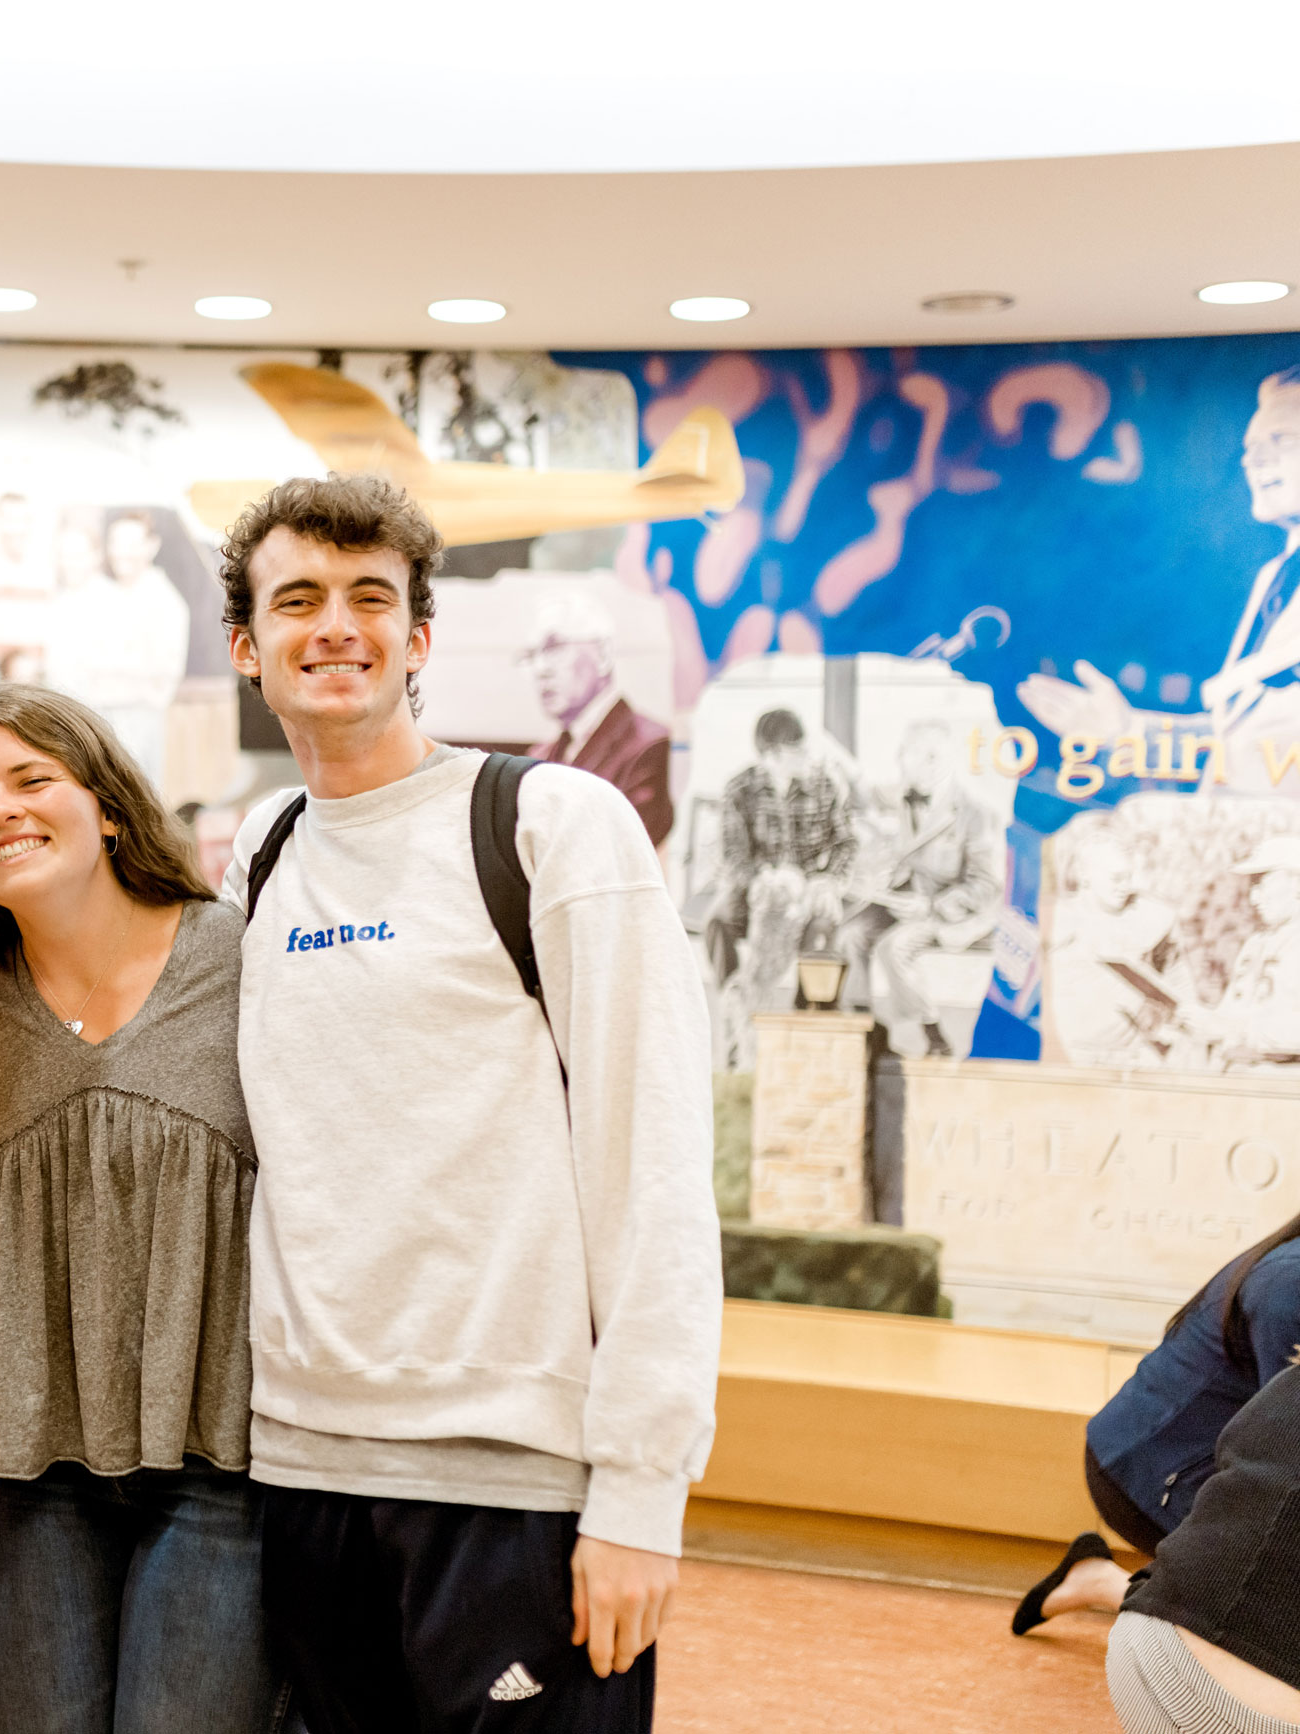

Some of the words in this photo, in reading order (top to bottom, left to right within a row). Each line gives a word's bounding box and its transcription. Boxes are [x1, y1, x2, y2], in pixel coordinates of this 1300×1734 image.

[967, 725, 1039, 778] to
[1056, 718, 1227, 800] gain
[286, 926, 334, 953] fear
[338, 920, 396, 944] not.
[1089, 1203, 1253, 1242] CHRIST
[488, 1685, 543, 1701] adidas
